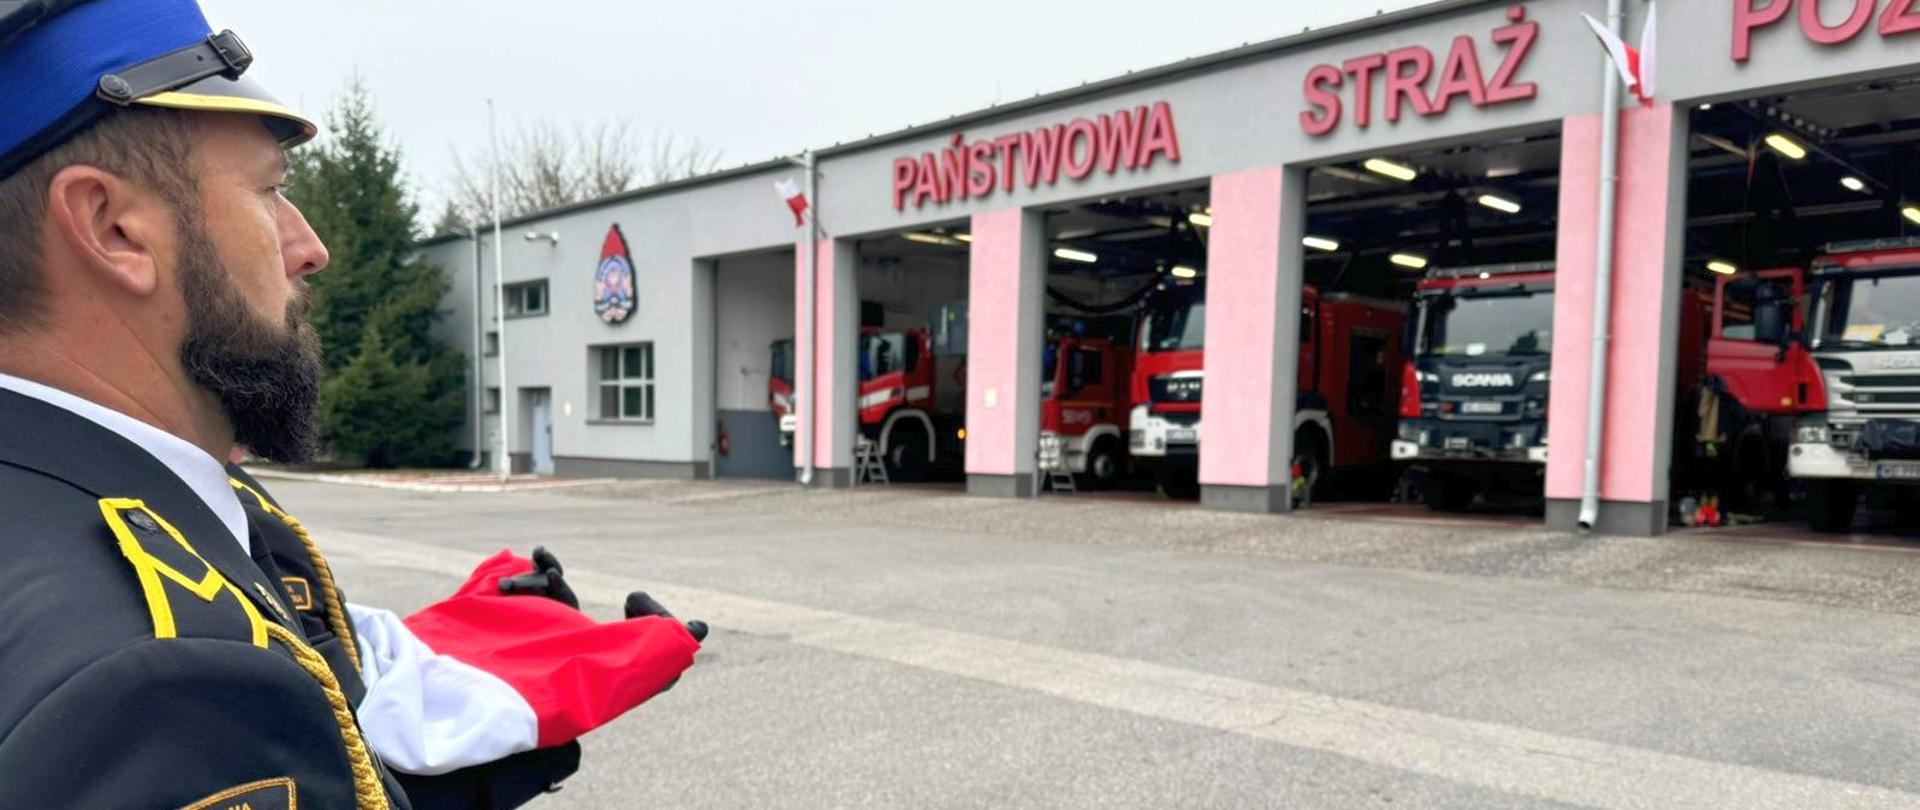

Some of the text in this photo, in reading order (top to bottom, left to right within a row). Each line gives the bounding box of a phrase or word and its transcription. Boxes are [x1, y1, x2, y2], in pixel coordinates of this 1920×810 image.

[894, 102, 1180, 210] PAŃSTWOWA
[1301, 6, 1538, 136] STRAŻ
[1452, 373, 1514, 388] SCANIA
